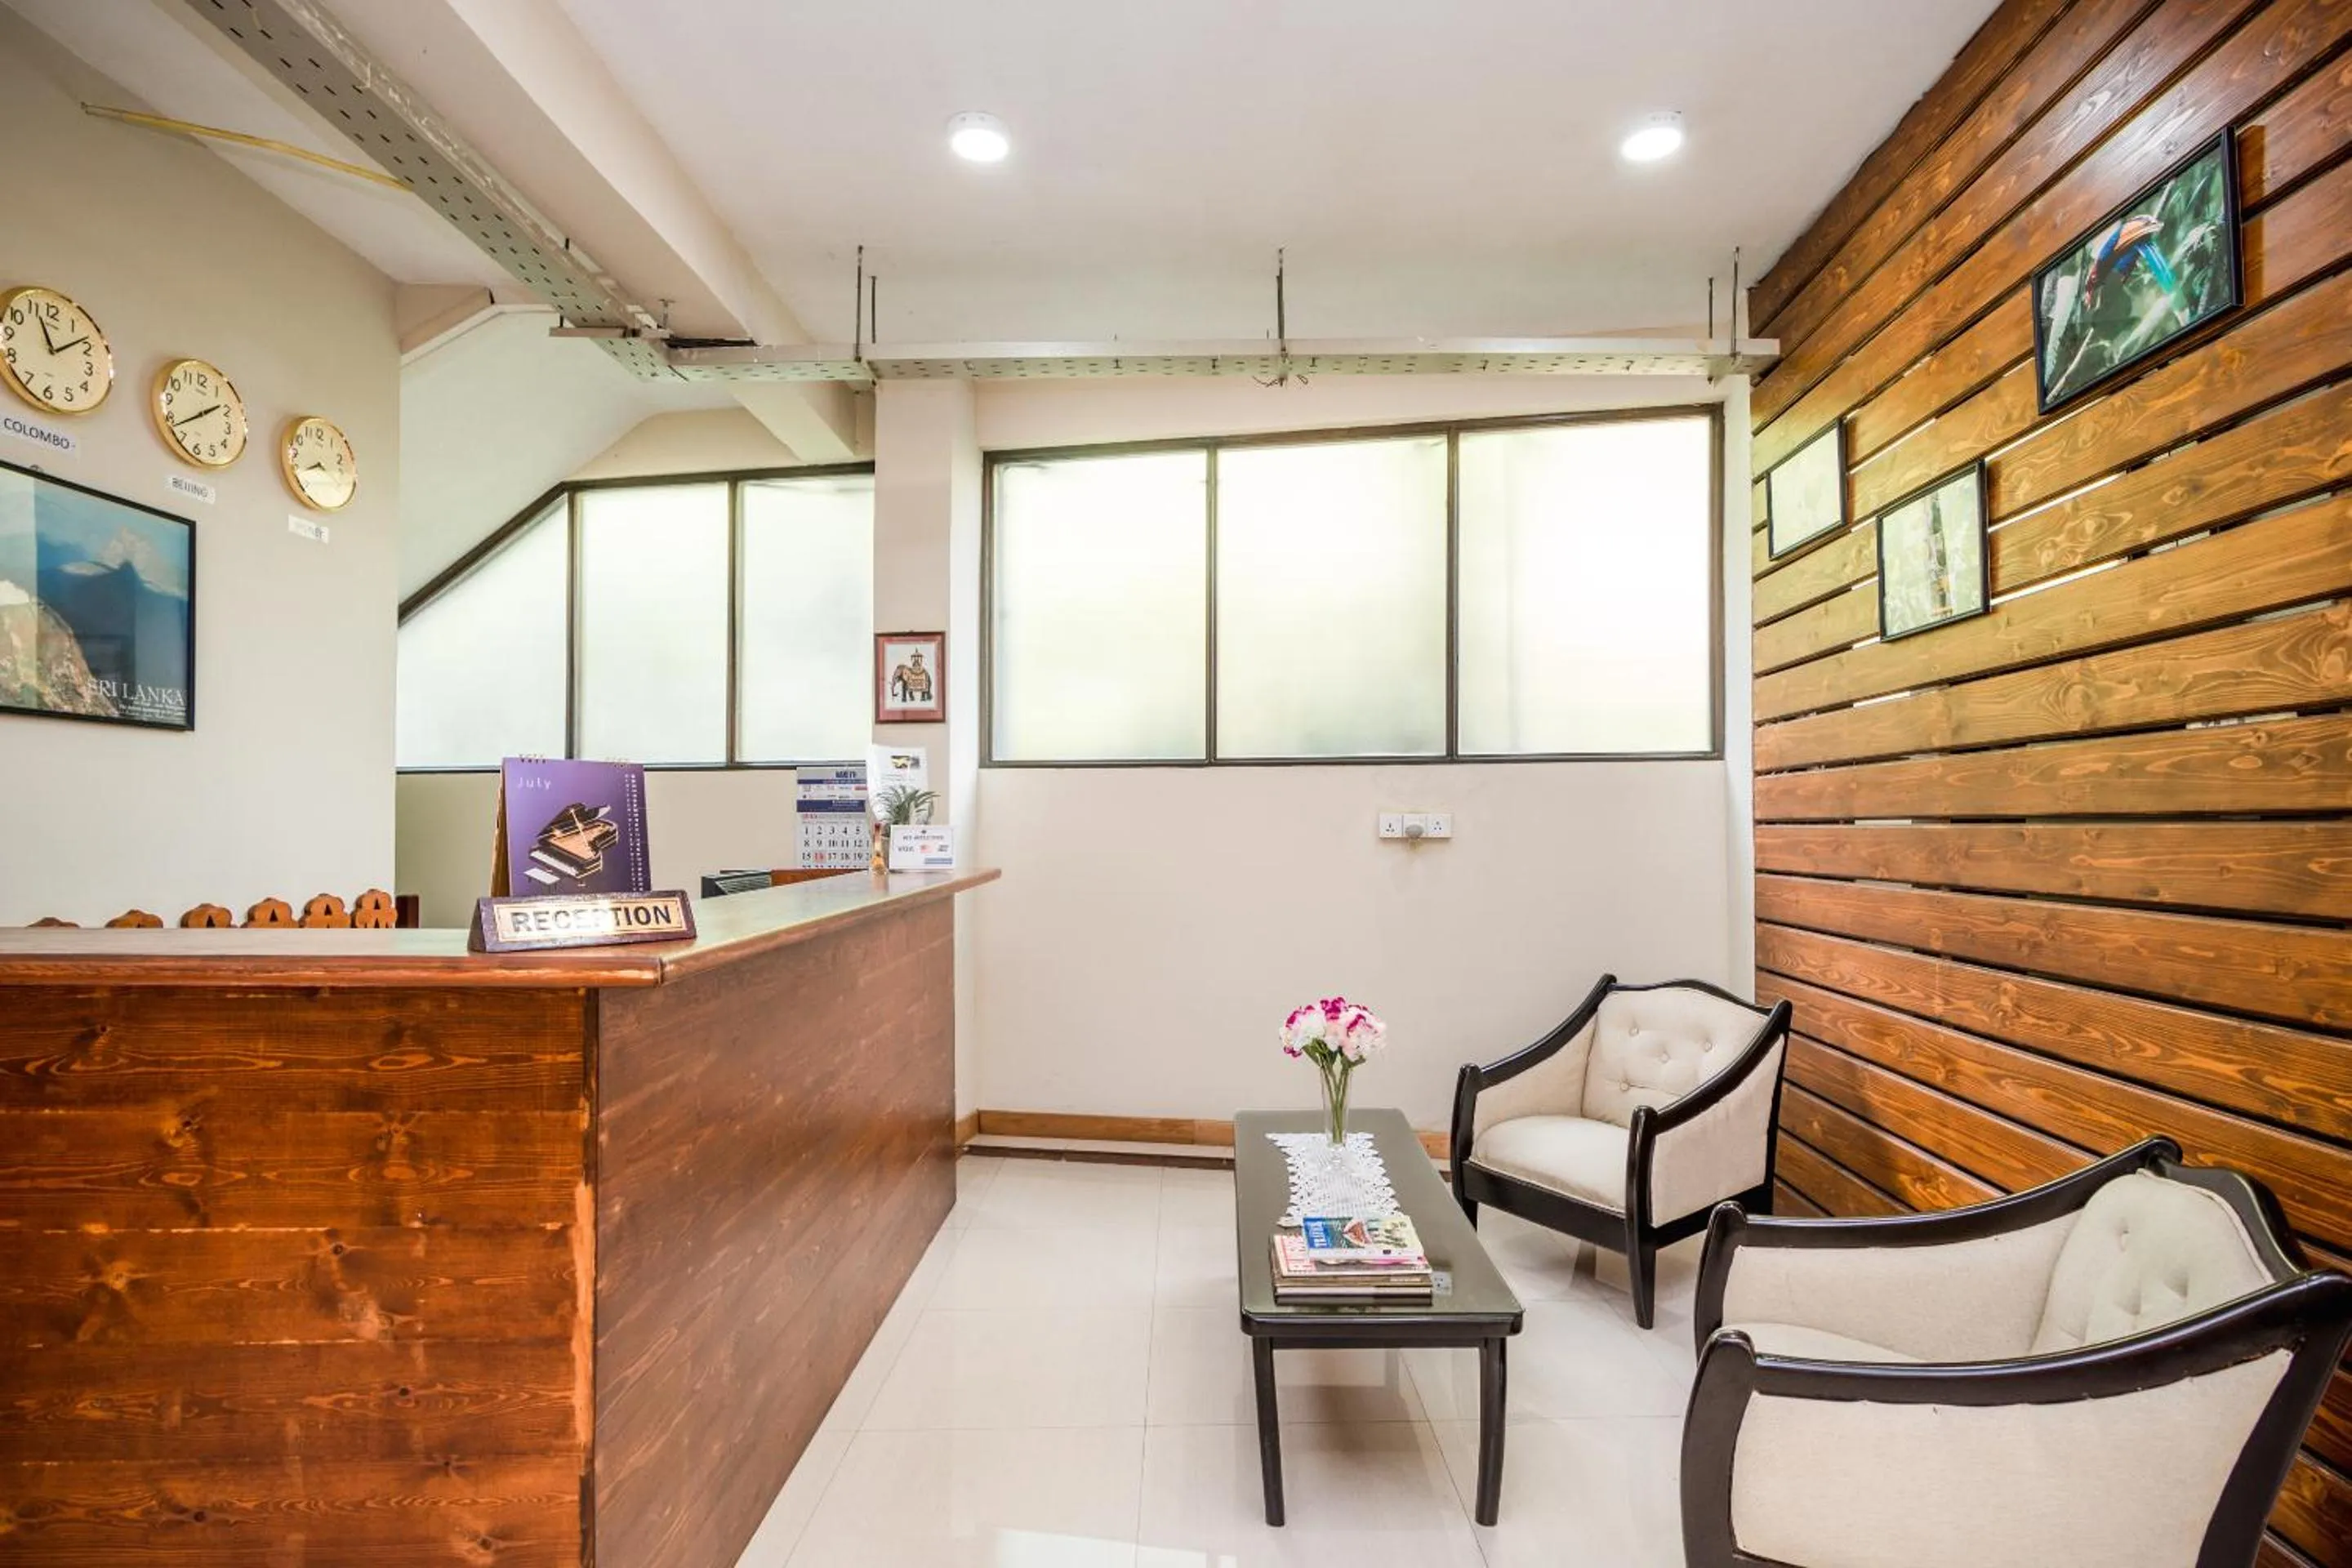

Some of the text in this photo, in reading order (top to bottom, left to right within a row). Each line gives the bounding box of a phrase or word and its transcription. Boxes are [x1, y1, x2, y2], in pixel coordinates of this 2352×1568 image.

[28, 299, 39, 317] 11
[46, 302, 60, 322] 12
[11, 307, 24, 325] 10
[71, 318, 75, 333] 1
[4, 326, 15, 341] 9
[82, 341, 92, 356] 2
[7, 348, 17, 364] 8
[85, 362, 94, 376] 3
[24, 371, 35, 385] 7
[170, 376, 181, 392] 10
[183, 370, 192, 385] 11
[197, 372, 207, 389] 12
[43, 385, 53, 400] 6
[80, 381, 89, 393] 4
[214, 385, 218, 398] 1
[64, 387, 74, 402] 5
[165, 393, 174, 405] 9
[166, 410, 175, 424] 8
[223, 405, 232, 418] 2
[4, 418, 70, 450] COLOMBO
[224, 422, 232, 435] 3
[305, 426, 313, 439] 11
[179, 430, 187, 442] 7
[192, 443, 201, 456] 6
[220, 438, 227, 449] 4
[330, 438, 334, 450] 1
[209, 445, 216, 457] 5
[336, 453, 343, 465] 2
[87, 679, 185, 706] SRI LANKA
[517, 777, 551, 790] July
[805, 825, 861, 835] 1 2 3 4 5
[804, 839, 810, 847] 8
[829, 839, 837, 847] 10
[841, 840, 849, 848] 11
[854, 839, 862, 848] 12
[510, 905, 672, 932] RECEPTION
